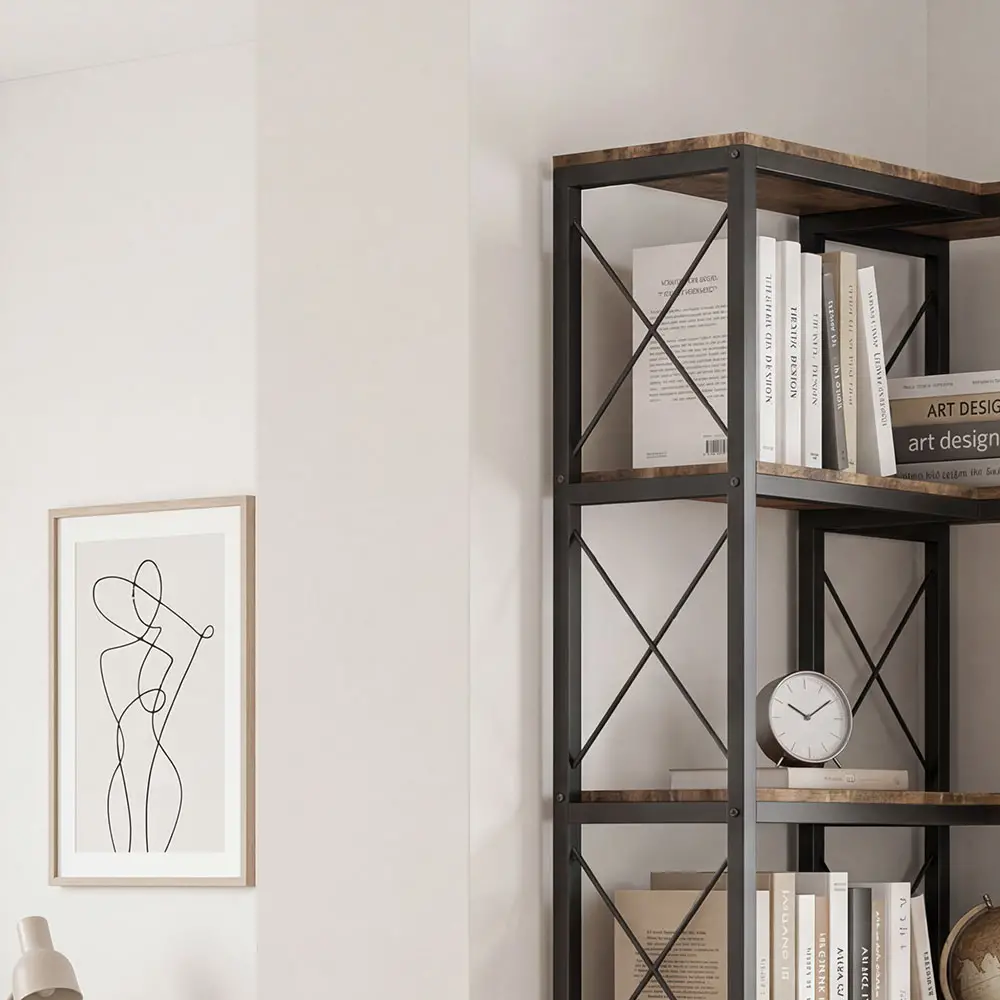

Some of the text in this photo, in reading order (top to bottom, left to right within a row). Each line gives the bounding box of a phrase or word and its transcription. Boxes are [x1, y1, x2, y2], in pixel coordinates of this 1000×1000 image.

[927, 402, 955, 418] ART
[908, 429, 1000, 452] art design
